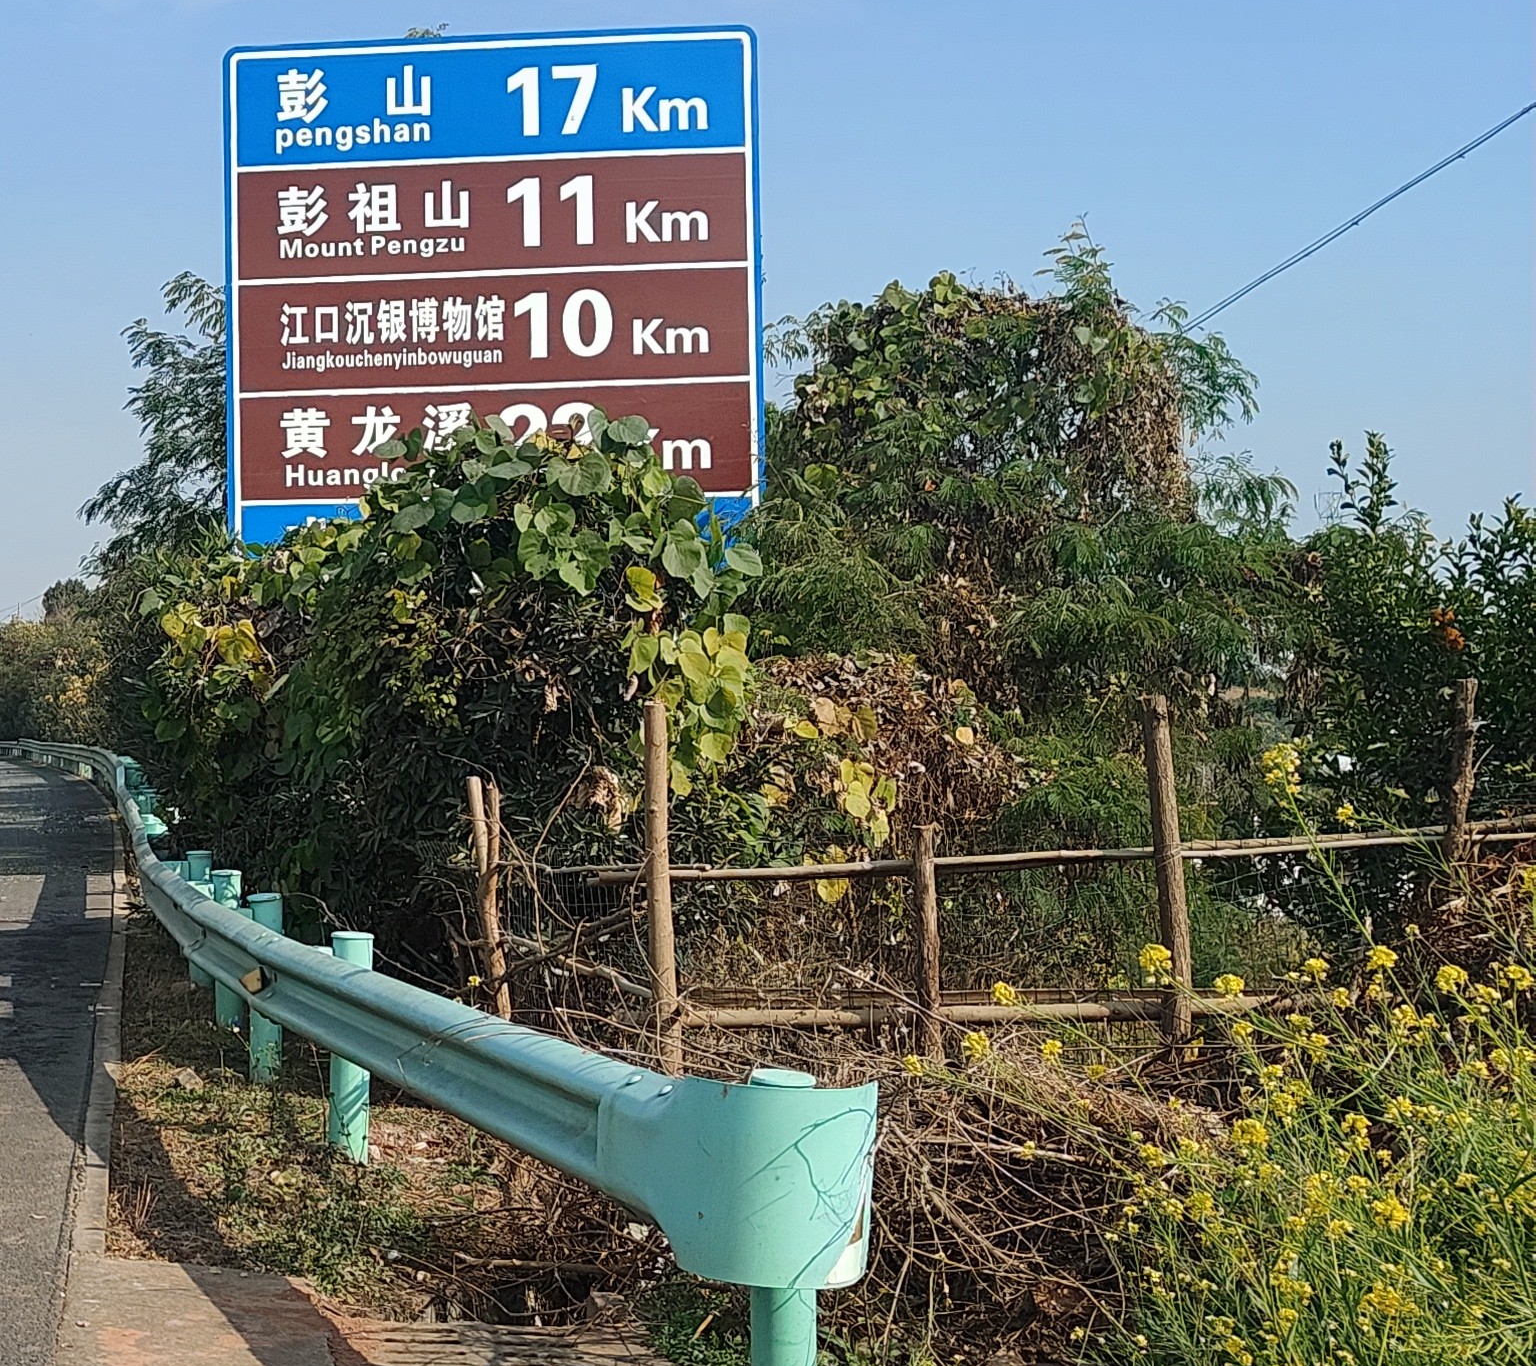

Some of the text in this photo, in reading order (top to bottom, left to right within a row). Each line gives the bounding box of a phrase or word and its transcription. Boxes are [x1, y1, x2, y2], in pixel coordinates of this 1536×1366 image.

[276, 64, 708, 136] 彭山 17 Km
[276, 118, 431, 154] pengshan
[277, 175, 709, 247] 彭祖山 11 Km
[278, 235, 466, 259] Mount Pengzu
[280, 289, 710, 359] 江口沉银博物馆 10 Km
[281, 347, 503, 371] Jiangkouchenyinbowuguan
